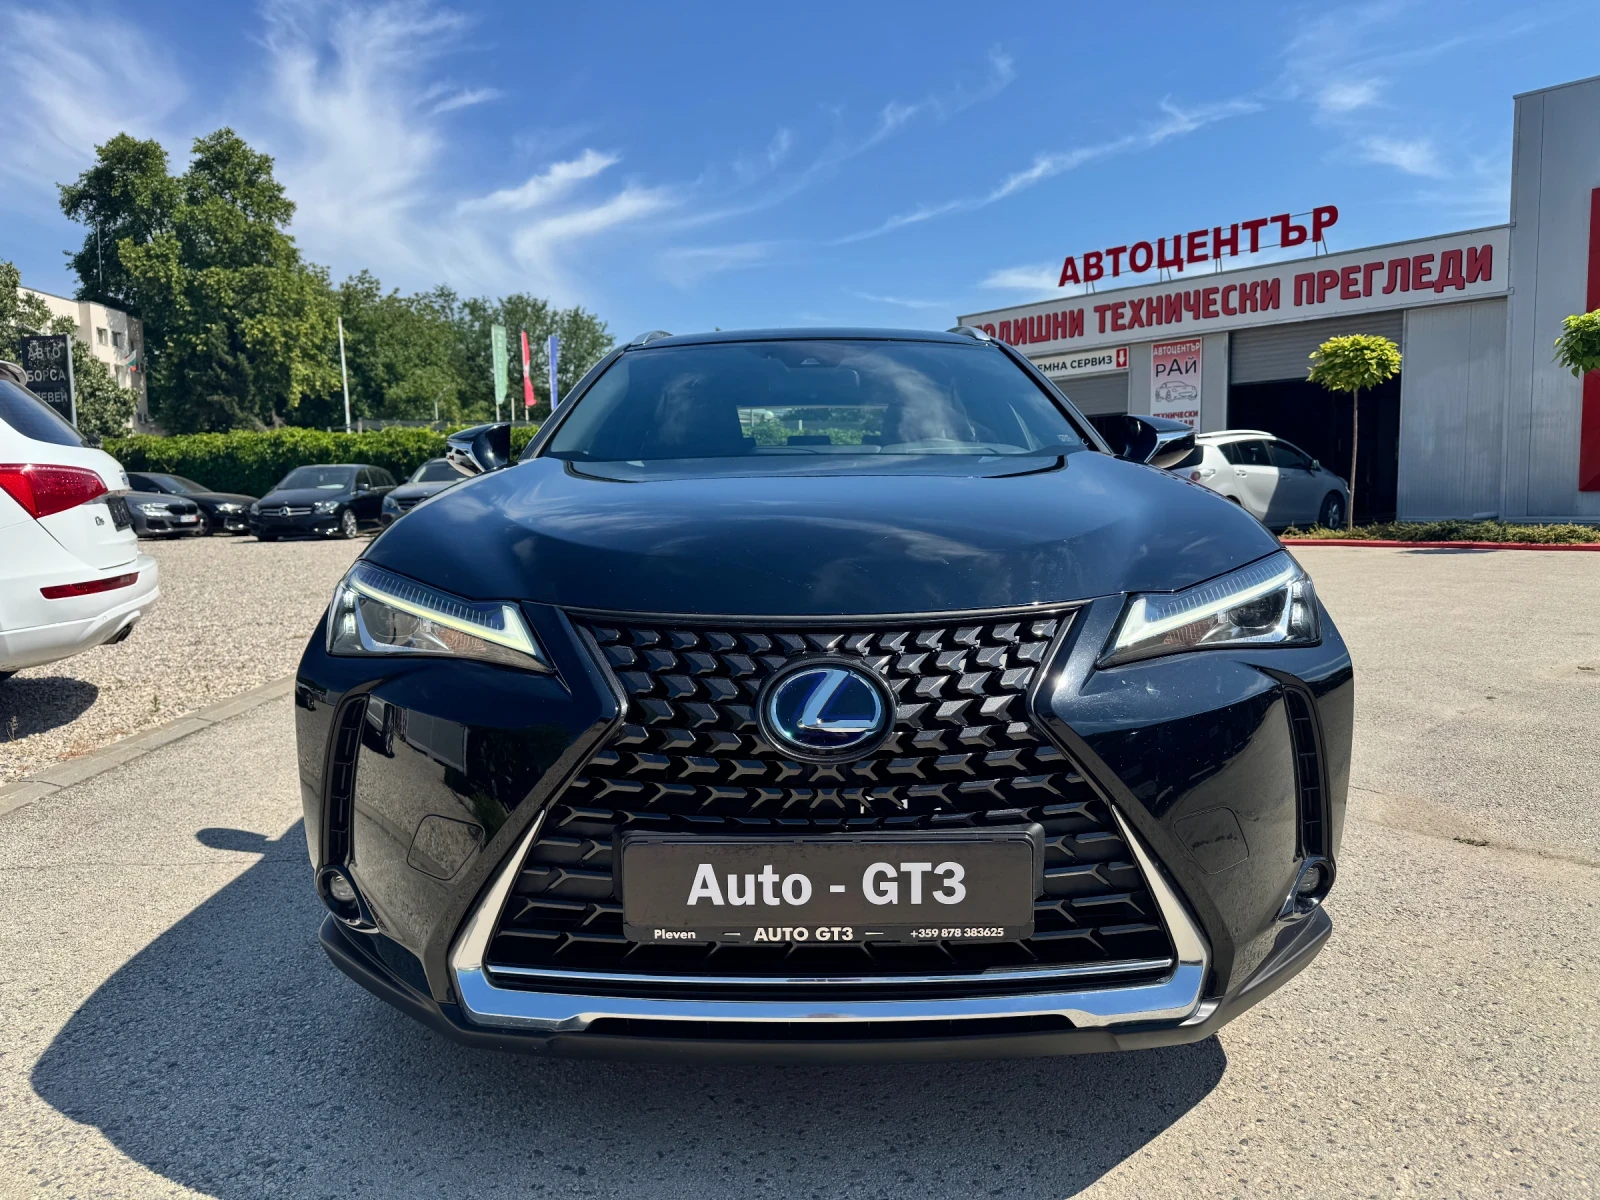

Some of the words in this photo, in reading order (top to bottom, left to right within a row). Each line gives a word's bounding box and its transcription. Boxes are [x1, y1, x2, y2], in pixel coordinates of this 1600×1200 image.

[1058, 205, 1339, 287] АВТОЦЕНТЪР
[1094, 277, 1281, 334] ТЕХНИЧЕСКИ
[1293, 243, 1494, 308] ПРЕГЛЕДИ
[28, 346, 61, 360] АВТО
[1153, 342, 1200, 356] АВТОЦЕНТЪР
[1038, 361, 1067, 372] ЕМНА
[1070, 355, 1113, 369] СЕРВИЗ
[27, 368, 66, 382] БОРСА
[37, 391, 68, 403] ЕВЕН
[686, 863, 813, 906] Auto
[862, 861, 967, 905] GT3
[654, 928, 696, 940] Pleven
[753, 927, 809, 942] AUTO
[815, 927, 854, 941] GT3
[910, 928, 939, 938] +359
[941, 928, 962, 938] 878
[964, 927, 1005, 938] 383625
